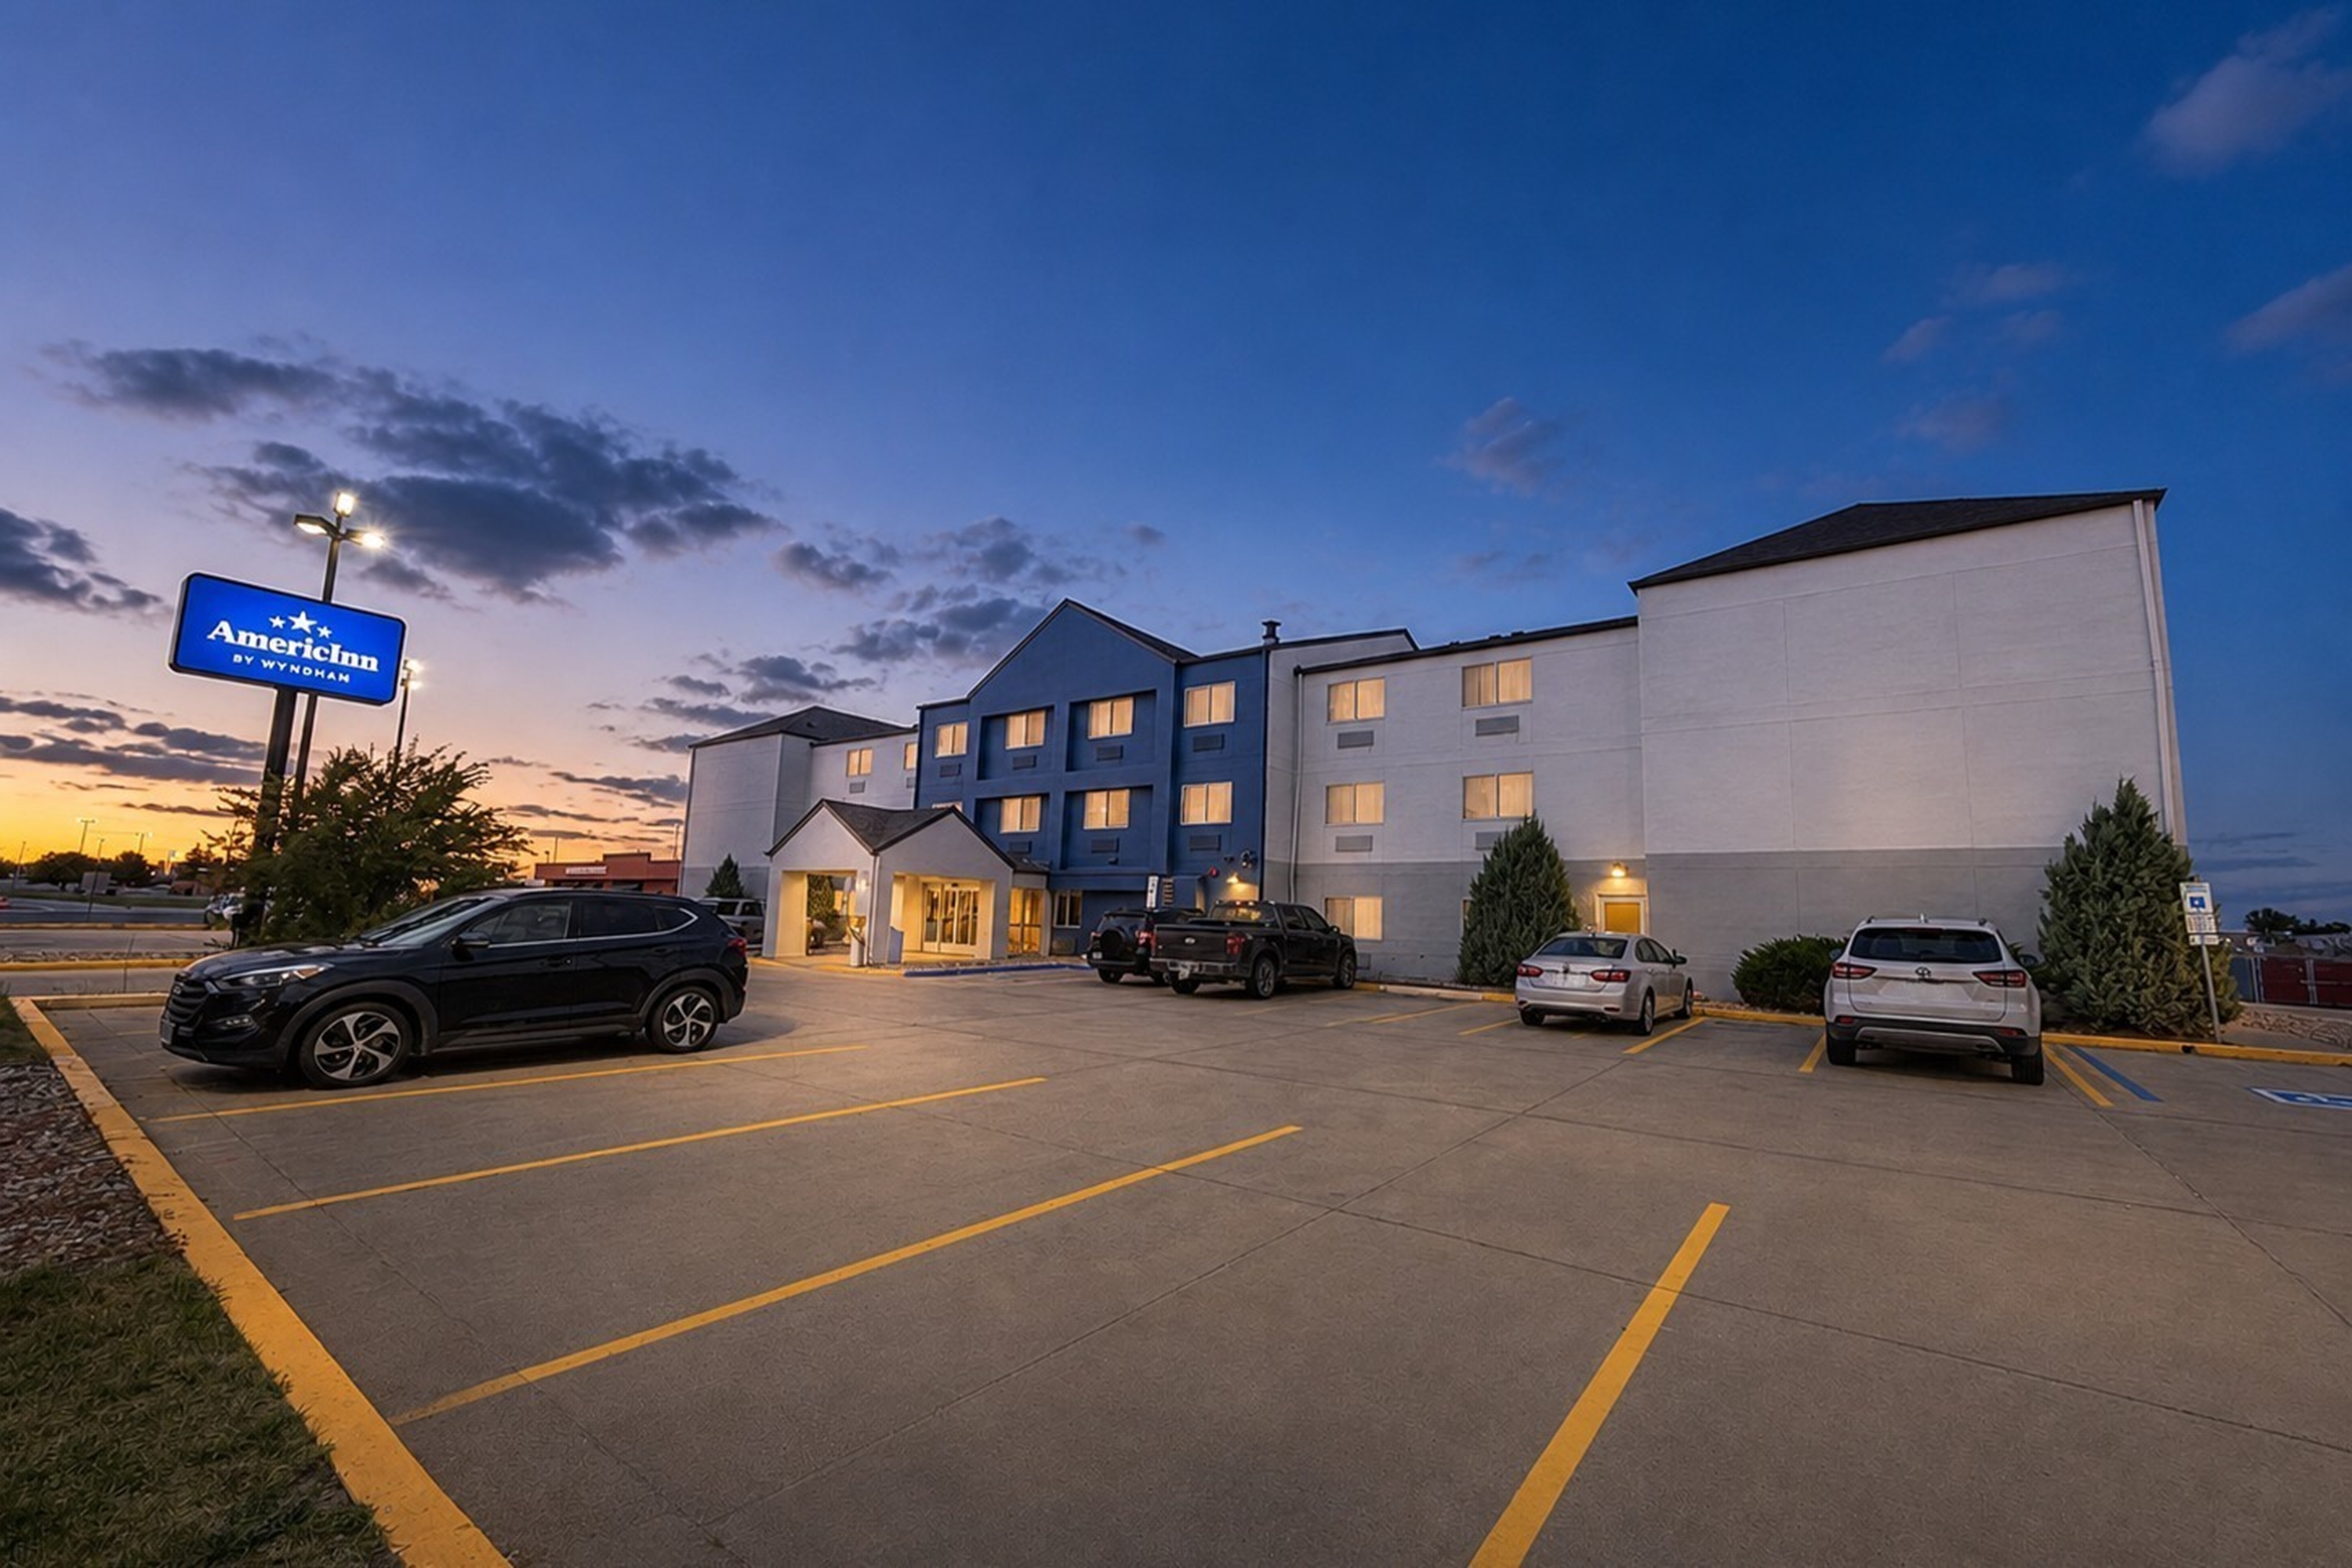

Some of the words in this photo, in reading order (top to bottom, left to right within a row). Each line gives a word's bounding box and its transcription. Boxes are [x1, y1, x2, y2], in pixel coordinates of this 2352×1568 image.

[207, 620, 379, 672] AmericInn
[233, 654, 254, 665] BY
[261, 659, 350, 683] WYNDHAM
